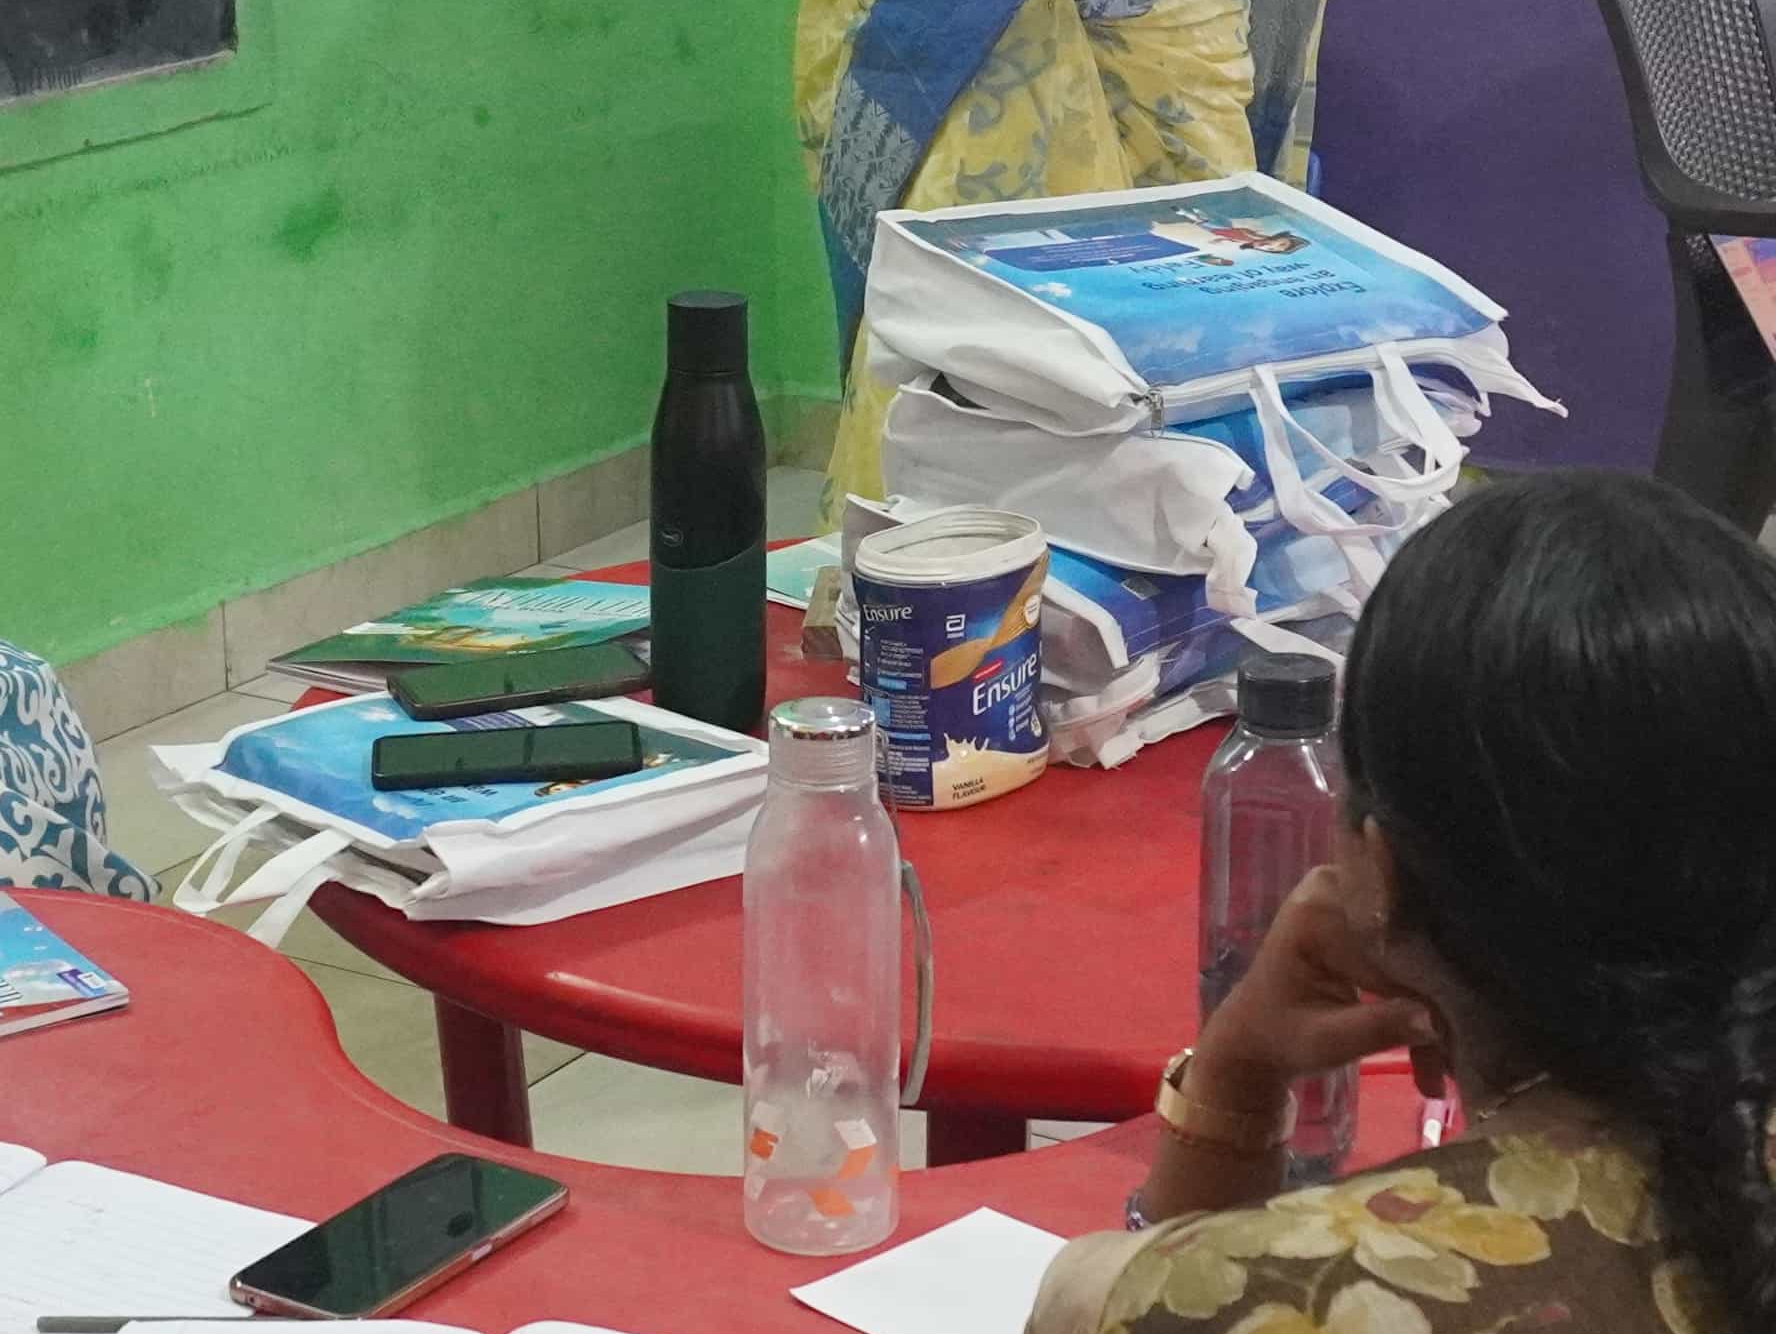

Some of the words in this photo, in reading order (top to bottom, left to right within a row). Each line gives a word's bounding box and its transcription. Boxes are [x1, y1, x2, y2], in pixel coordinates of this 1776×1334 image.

[1280, 280, 1367, 299] Explore
[862, 604, 912, 622] Ensure
[972, 652, 1037, 716] Ensure
[952, 776, 984, 792] VANILLA
[952, 784, 987, 801] FLAVOUR
